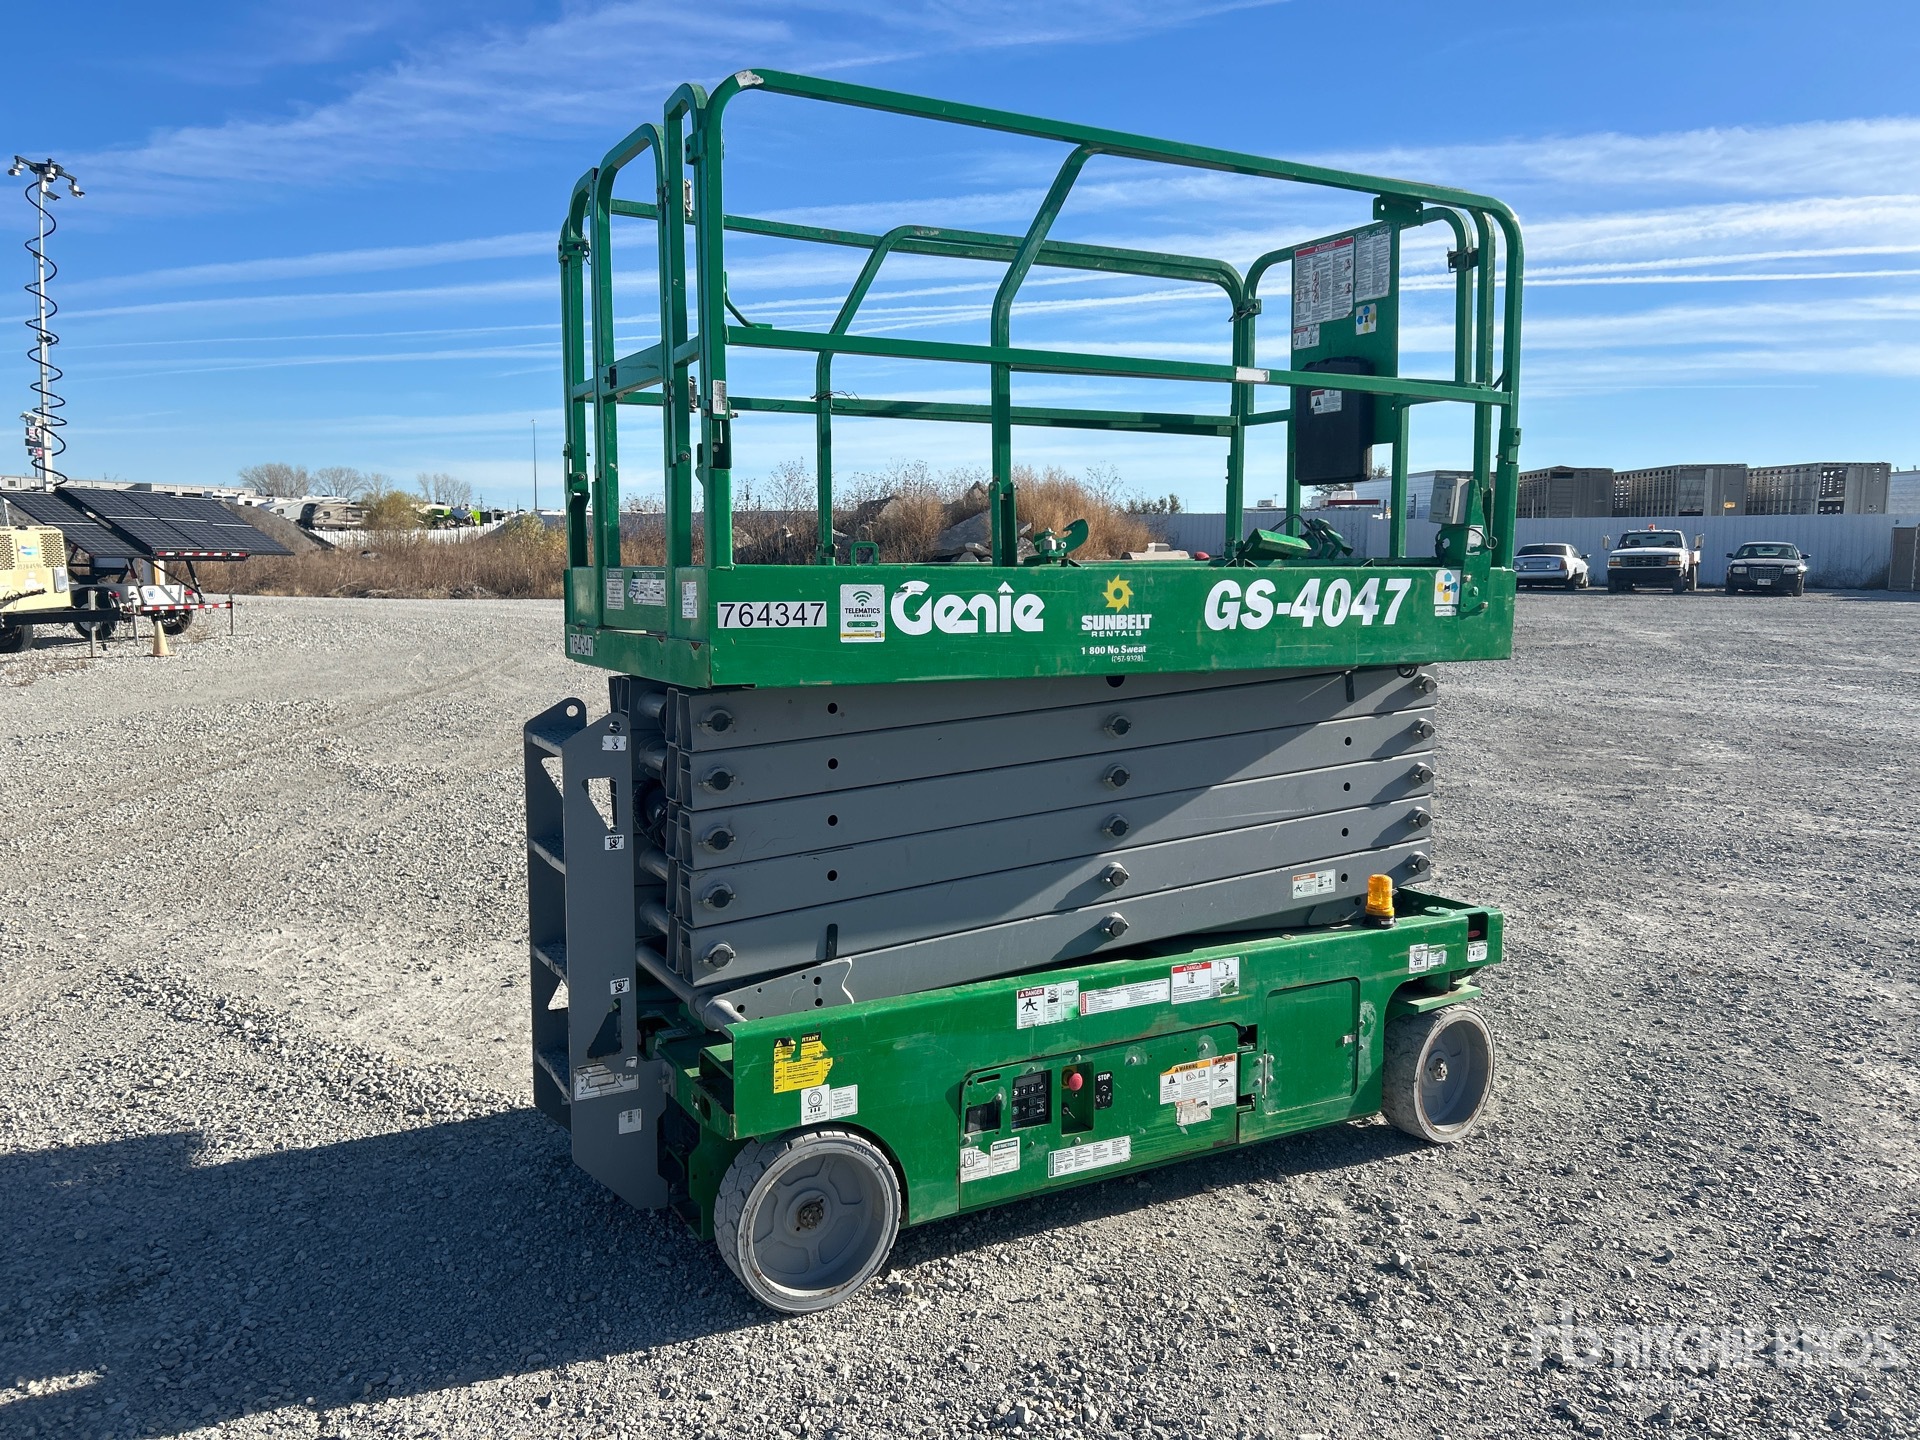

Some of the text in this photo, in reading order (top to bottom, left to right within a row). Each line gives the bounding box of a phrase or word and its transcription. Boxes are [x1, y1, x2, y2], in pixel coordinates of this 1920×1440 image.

[1204, 578, 1412, 631] GS-4047
[720, 602, 824, 628] 764347
[1081, 613, 1152, 631] SUNBELT
[1091, 630, 1142, 638] RENTALS
[570, 634, 593, 656] 764347
[1081, 644, 1147, 655] 1 800 No Sweat
[1024, 988, 1043, 997] DANGER
[1097, 1073, 1111, 1082] STOP
